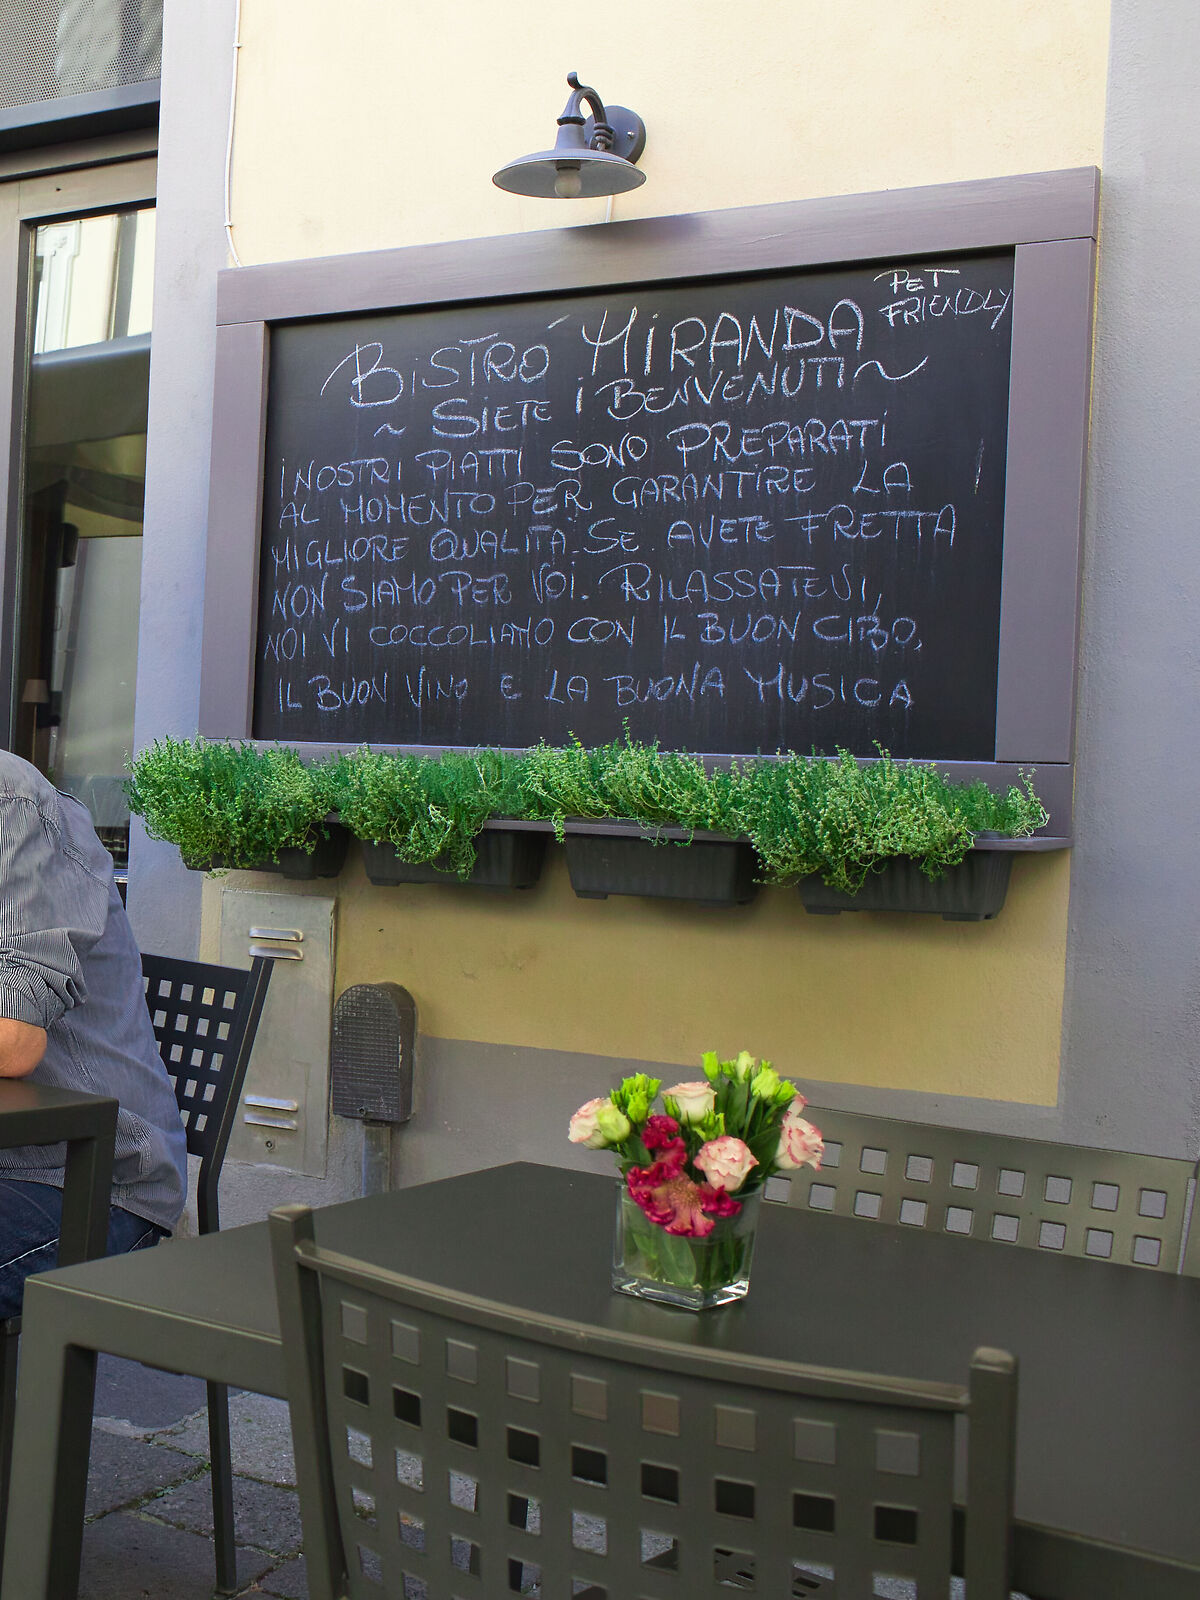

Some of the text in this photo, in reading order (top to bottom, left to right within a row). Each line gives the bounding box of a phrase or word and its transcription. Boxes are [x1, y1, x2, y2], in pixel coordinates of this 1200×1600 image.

[873, 268, 960, 294] PET
[878, 287, 1012, 330] FRIENDLY
[432, 397, 552, 438] SIETE
[595, 356, 845, 420] BENVENUTI
[415, 448, 524, 482] PIATTI
[550, 432, 648, 471] SONO
[666, 410, 888, 468] PREPARATI
[279, 460, 914, 529] AL MOMENTO PER GARANTIRE LA
[271, 534, 410, 576] MIGLIORE
[667, 514, 777, 549] AVETE
[784, 503, 957, 547] FRETTA
[272, 571, 329, 621] NON
[341, 571, 437, 612] SIAMO
[438, 570, 512, 607] PER
[264, 627, 306, 662] NOI
[323, 617, 350, 658] VI
[369, 616, 556, 649] COCCOLIAMO
[567, 616, 636, 648] CON
[663, 612, 686, 647] IL
[697, 610, 801, 645] BUON
[279, 661, 915, 712] IL BUON VINO E LA BUONA MUSICA
